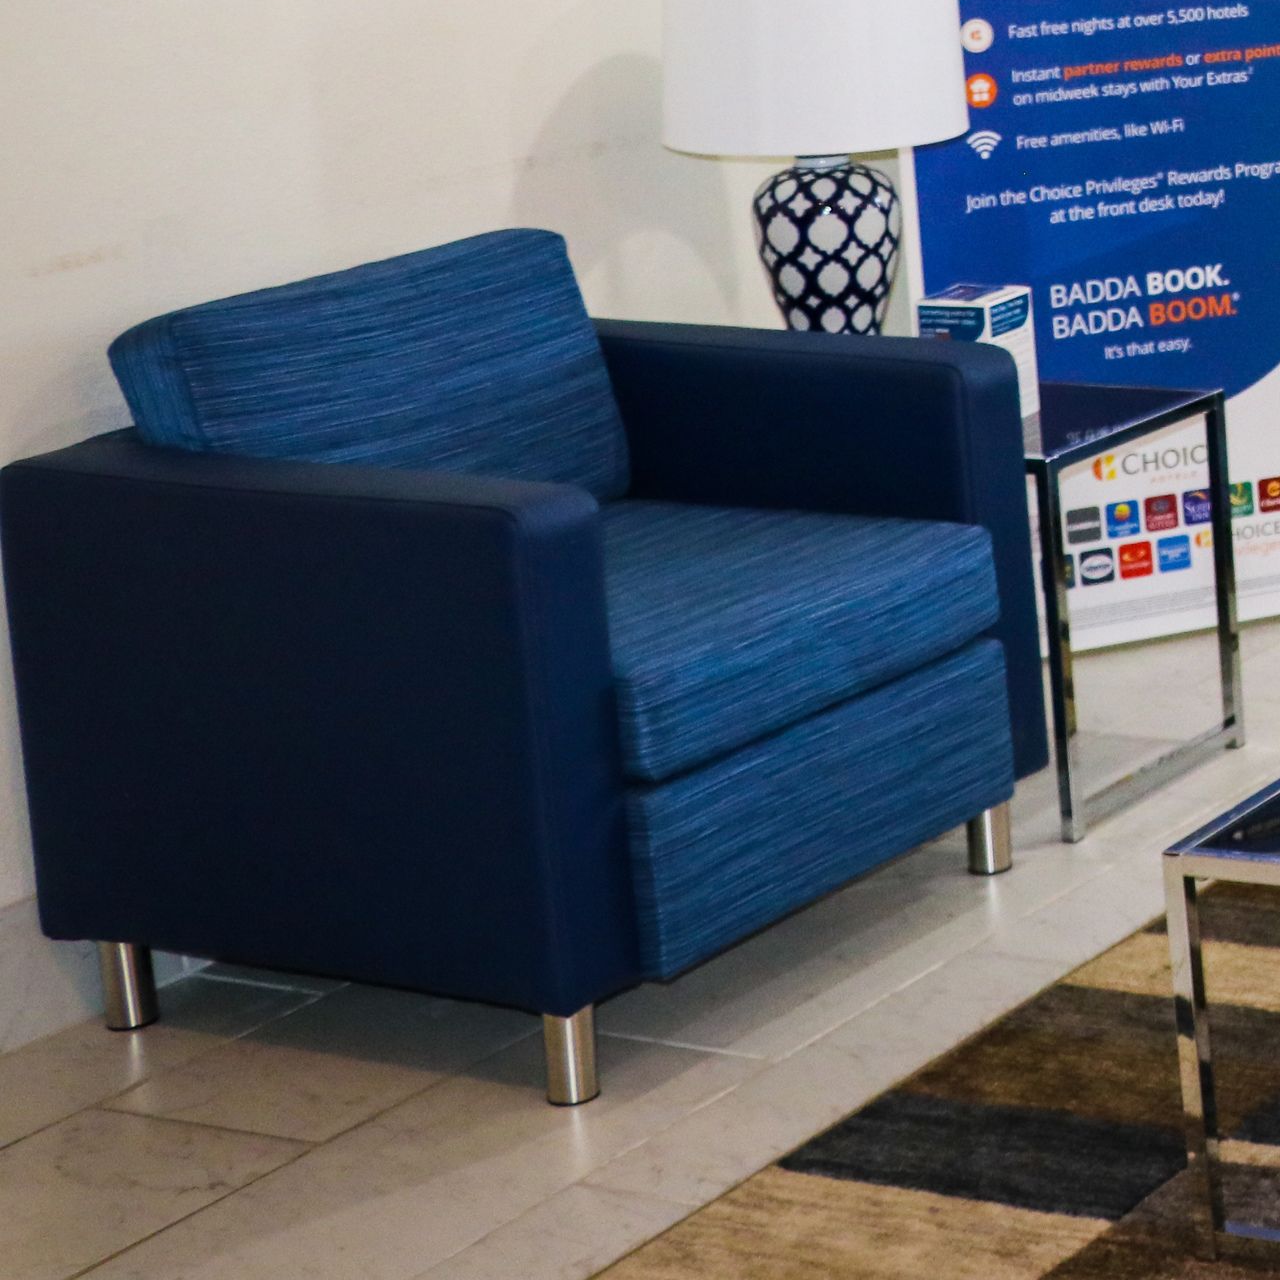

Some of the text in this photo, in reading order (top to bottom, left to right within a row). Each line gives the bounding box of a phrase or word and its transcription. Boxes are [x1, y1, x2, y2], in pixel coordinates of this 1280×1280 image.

[1008, 2, 1249, 39] Fast free nights at over 5,500 hotels
[1011, 66, 1061, 83] Instant
[1063, 61, 1121, 80] partner
[1123, 54, 1183, 71] rewards
[1185, 54, 1200, 66] or
[1203, 49, 1242, 63] extra
[1013, 93, 1032, 106] on
[1035, 84, 1098, 103] midweek
[1102, 82, 1137, 98] stays
[1139, 77, 1170, 92] with
[1172, 75, 1203, 90] Your
[1016, 118, 1185, 150] Free amenities, like Wi-Fi
[965, 194, 997, 214] Join
[1000, 189, 1027, 206] the
[1029, 184, 1082, 203] Choice
[1168, 165, 1232, 186] Rewards
[1050, 189, 1226, 224] at the front desk today!
[1050, 263, 1231, 309] BADDA BOOK.
[1052, 306, 1144, 340] BADDA
[1104, 337, 1193, 360] It's that easy.
[1122, 444, 1208, 475] CHOIC
